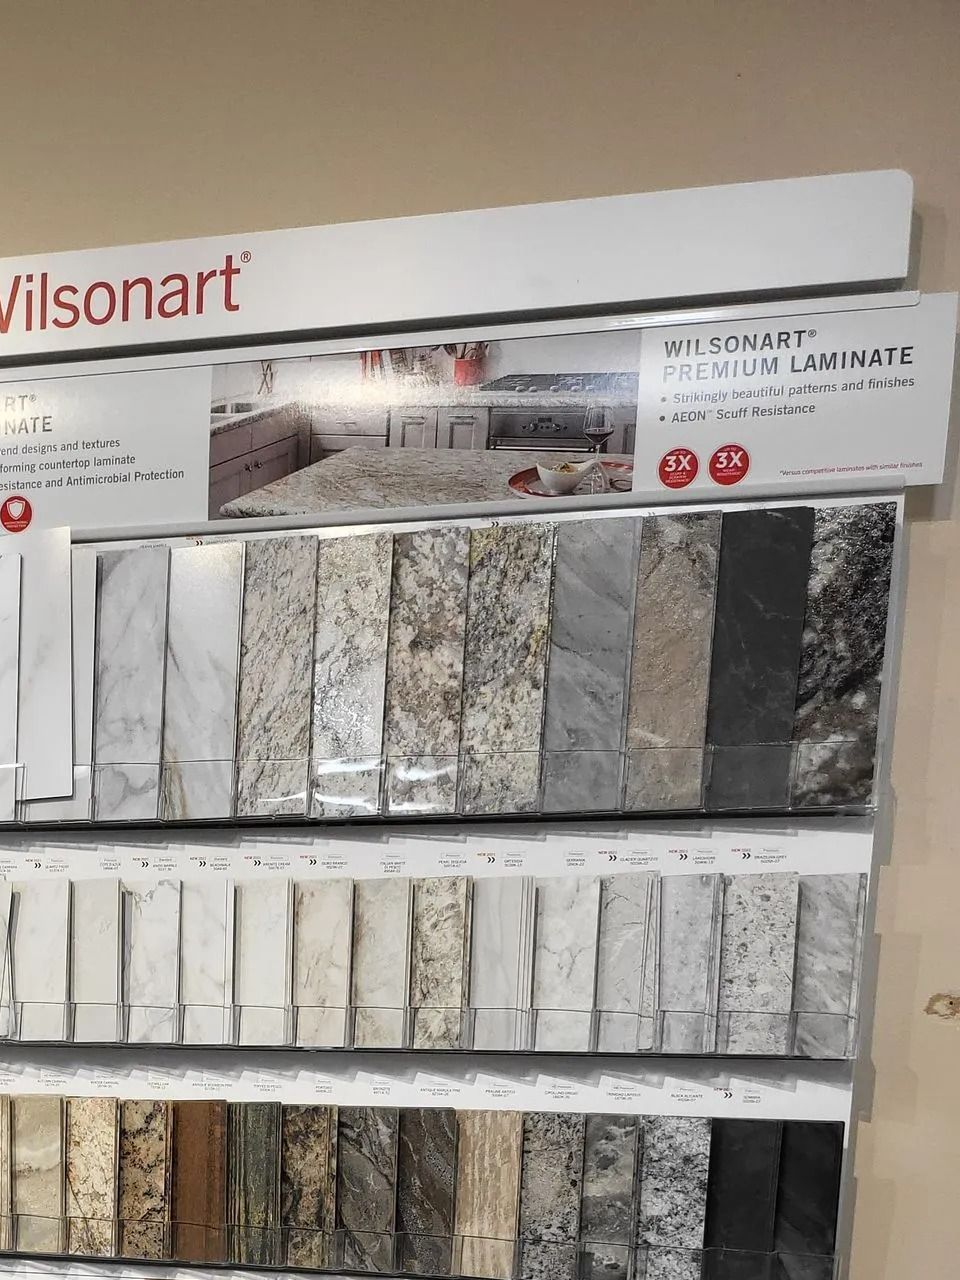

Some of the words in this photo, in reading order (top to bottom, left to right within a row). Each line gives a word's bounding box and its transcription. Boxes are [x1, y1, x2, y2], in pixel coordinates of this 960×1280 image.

[662, 357, 779, 383] PREMIUM
[790, 346, 914, 374] LAMINATE
[673, 390, 728, 405] Strikingly
[732, 386, 784, 400] beautiful
[788, 382, 837, 397] patterns
[841, 380, 864, 392] and
[867, 377, 915, 390] finishes
[716, 406, 748, 420] Scuff
[751, 402, 816, 417] Resistance
[21, 441, 57, 456] designs
[60, 440, 79, 451] and
[82, 437, 120, 450] textures
[39, 457, 90, 472] countertop
[93, 454, 136, 467] laminate
[665, 455, 692, 472] 3X
[715, 451, 744, 469] 3X
[45, 475, 63, 488] and
[66, 471, 131, 486] Antimicrobial
[134, 467, 184, 482] Protection
